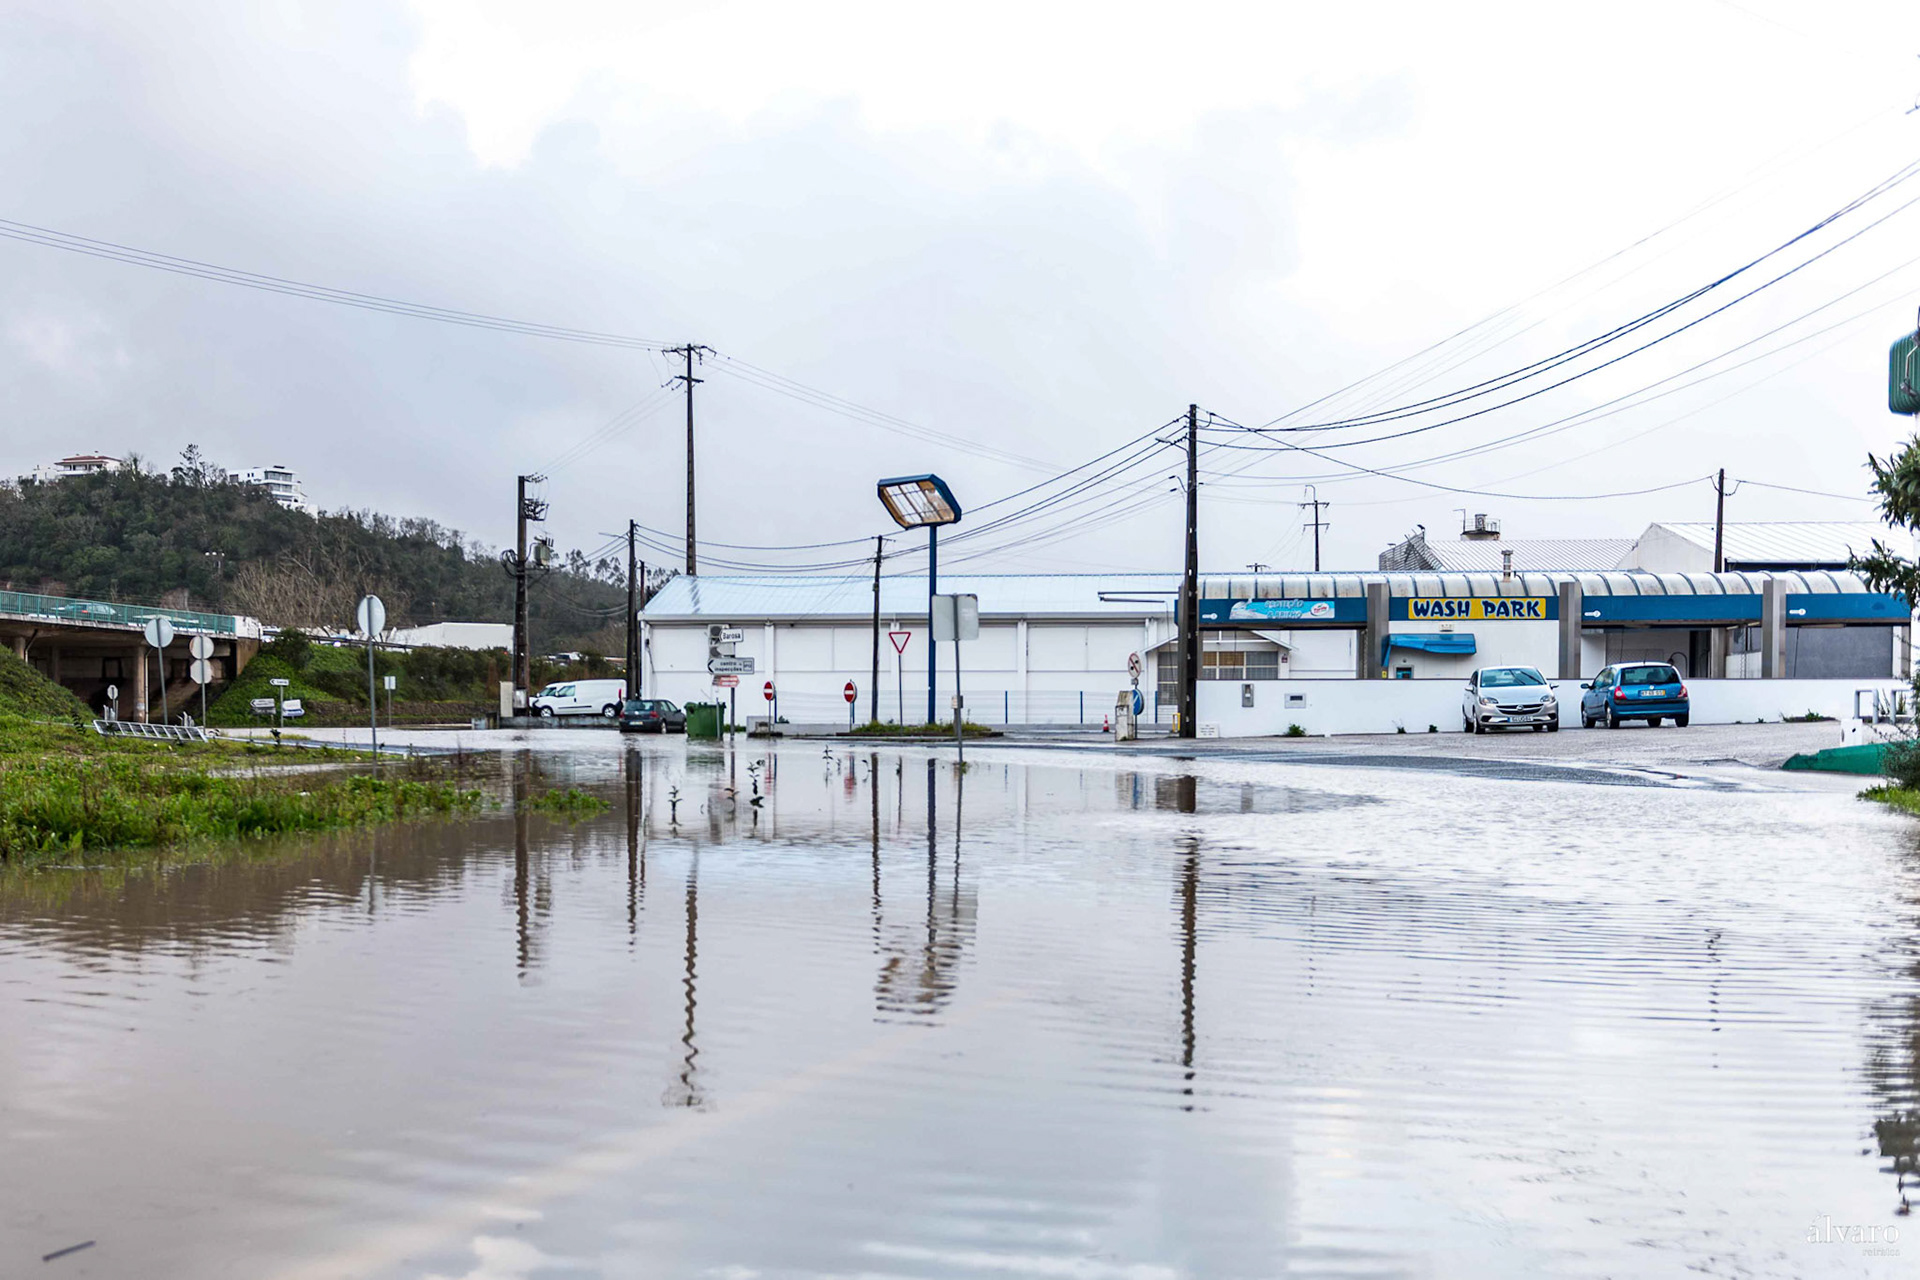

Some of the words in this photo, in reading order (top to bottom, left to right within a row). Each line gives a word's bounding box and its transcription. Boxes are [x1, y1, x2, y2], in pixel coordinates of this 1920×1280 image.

[1412, 600, 1471, 617] WASH
[1481, 600, 1541, 617] PARK
[722, 632, 741, 640] Barosa
